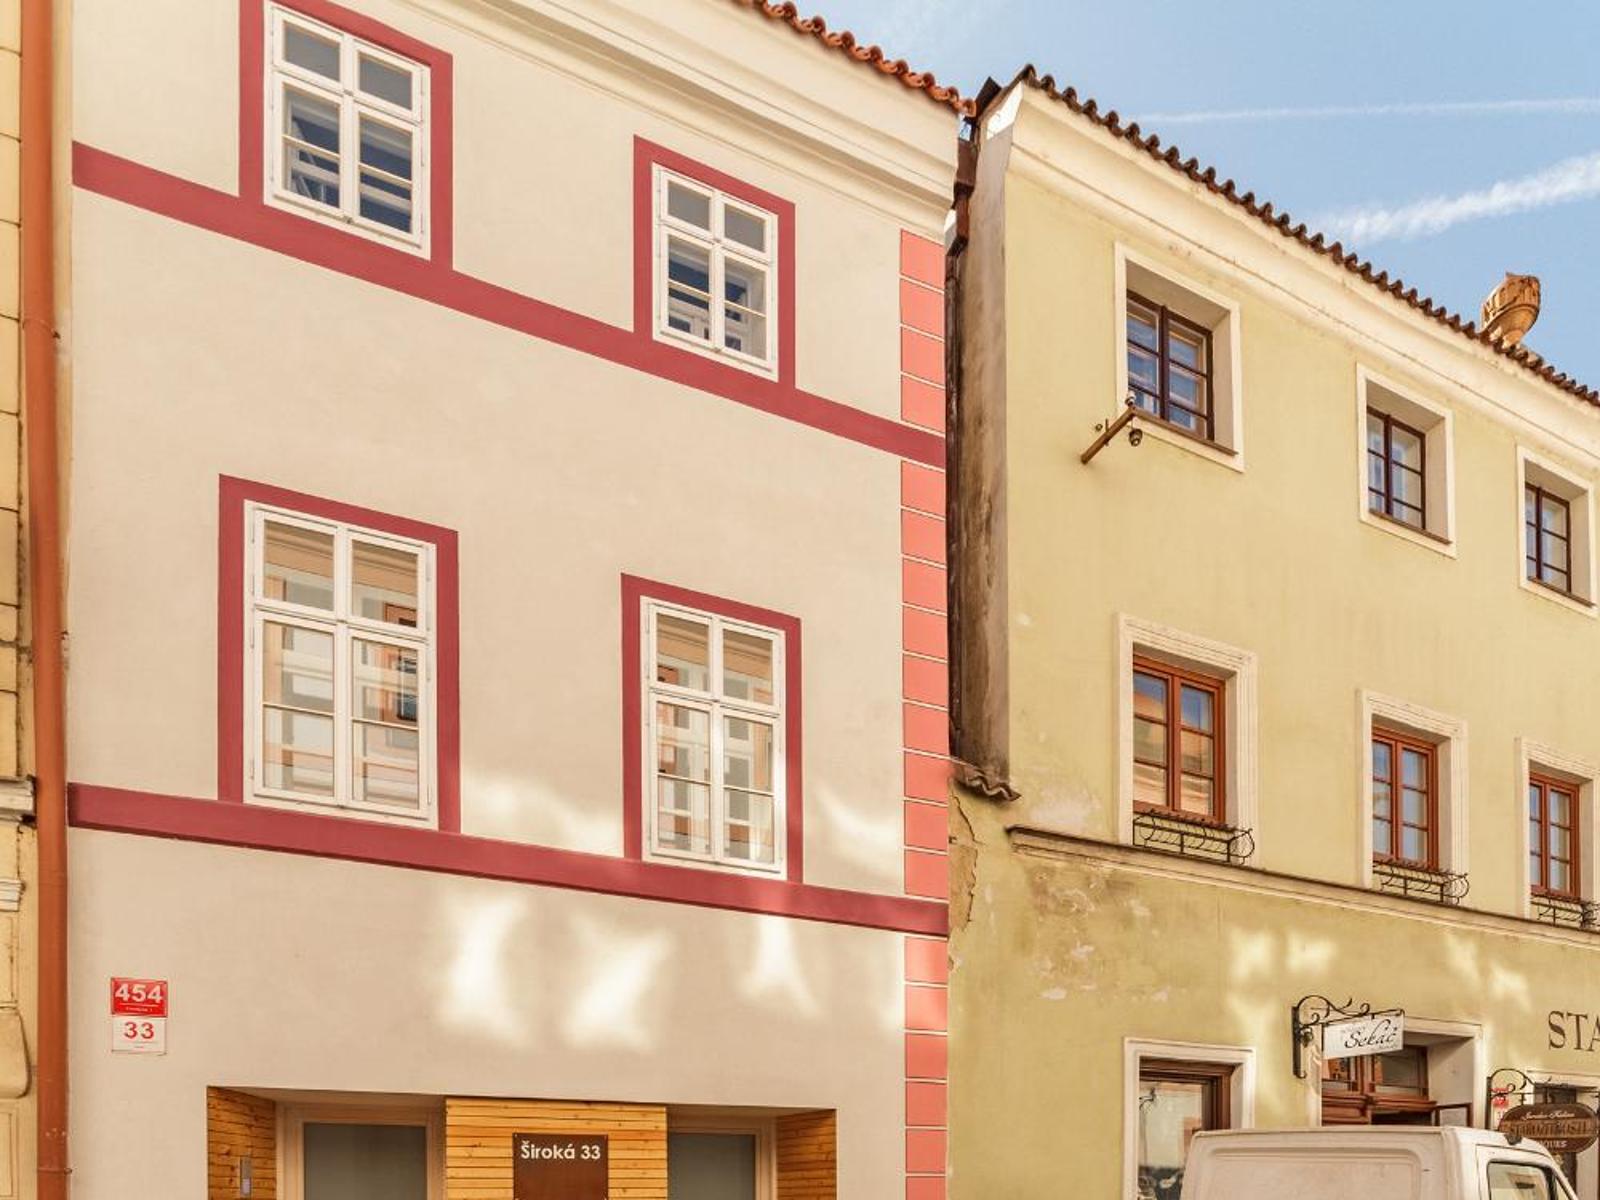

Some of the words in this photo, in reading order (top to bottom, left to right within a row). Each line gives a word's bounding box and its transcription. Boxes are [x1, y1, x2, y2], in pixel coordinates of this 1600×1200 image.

[115, 983, 163, 1004] 454
[124, 1021, 155, 1040] 33
[520, 1140, 576, 1160] Široká
[580, 1144, 602, 1160] 33
